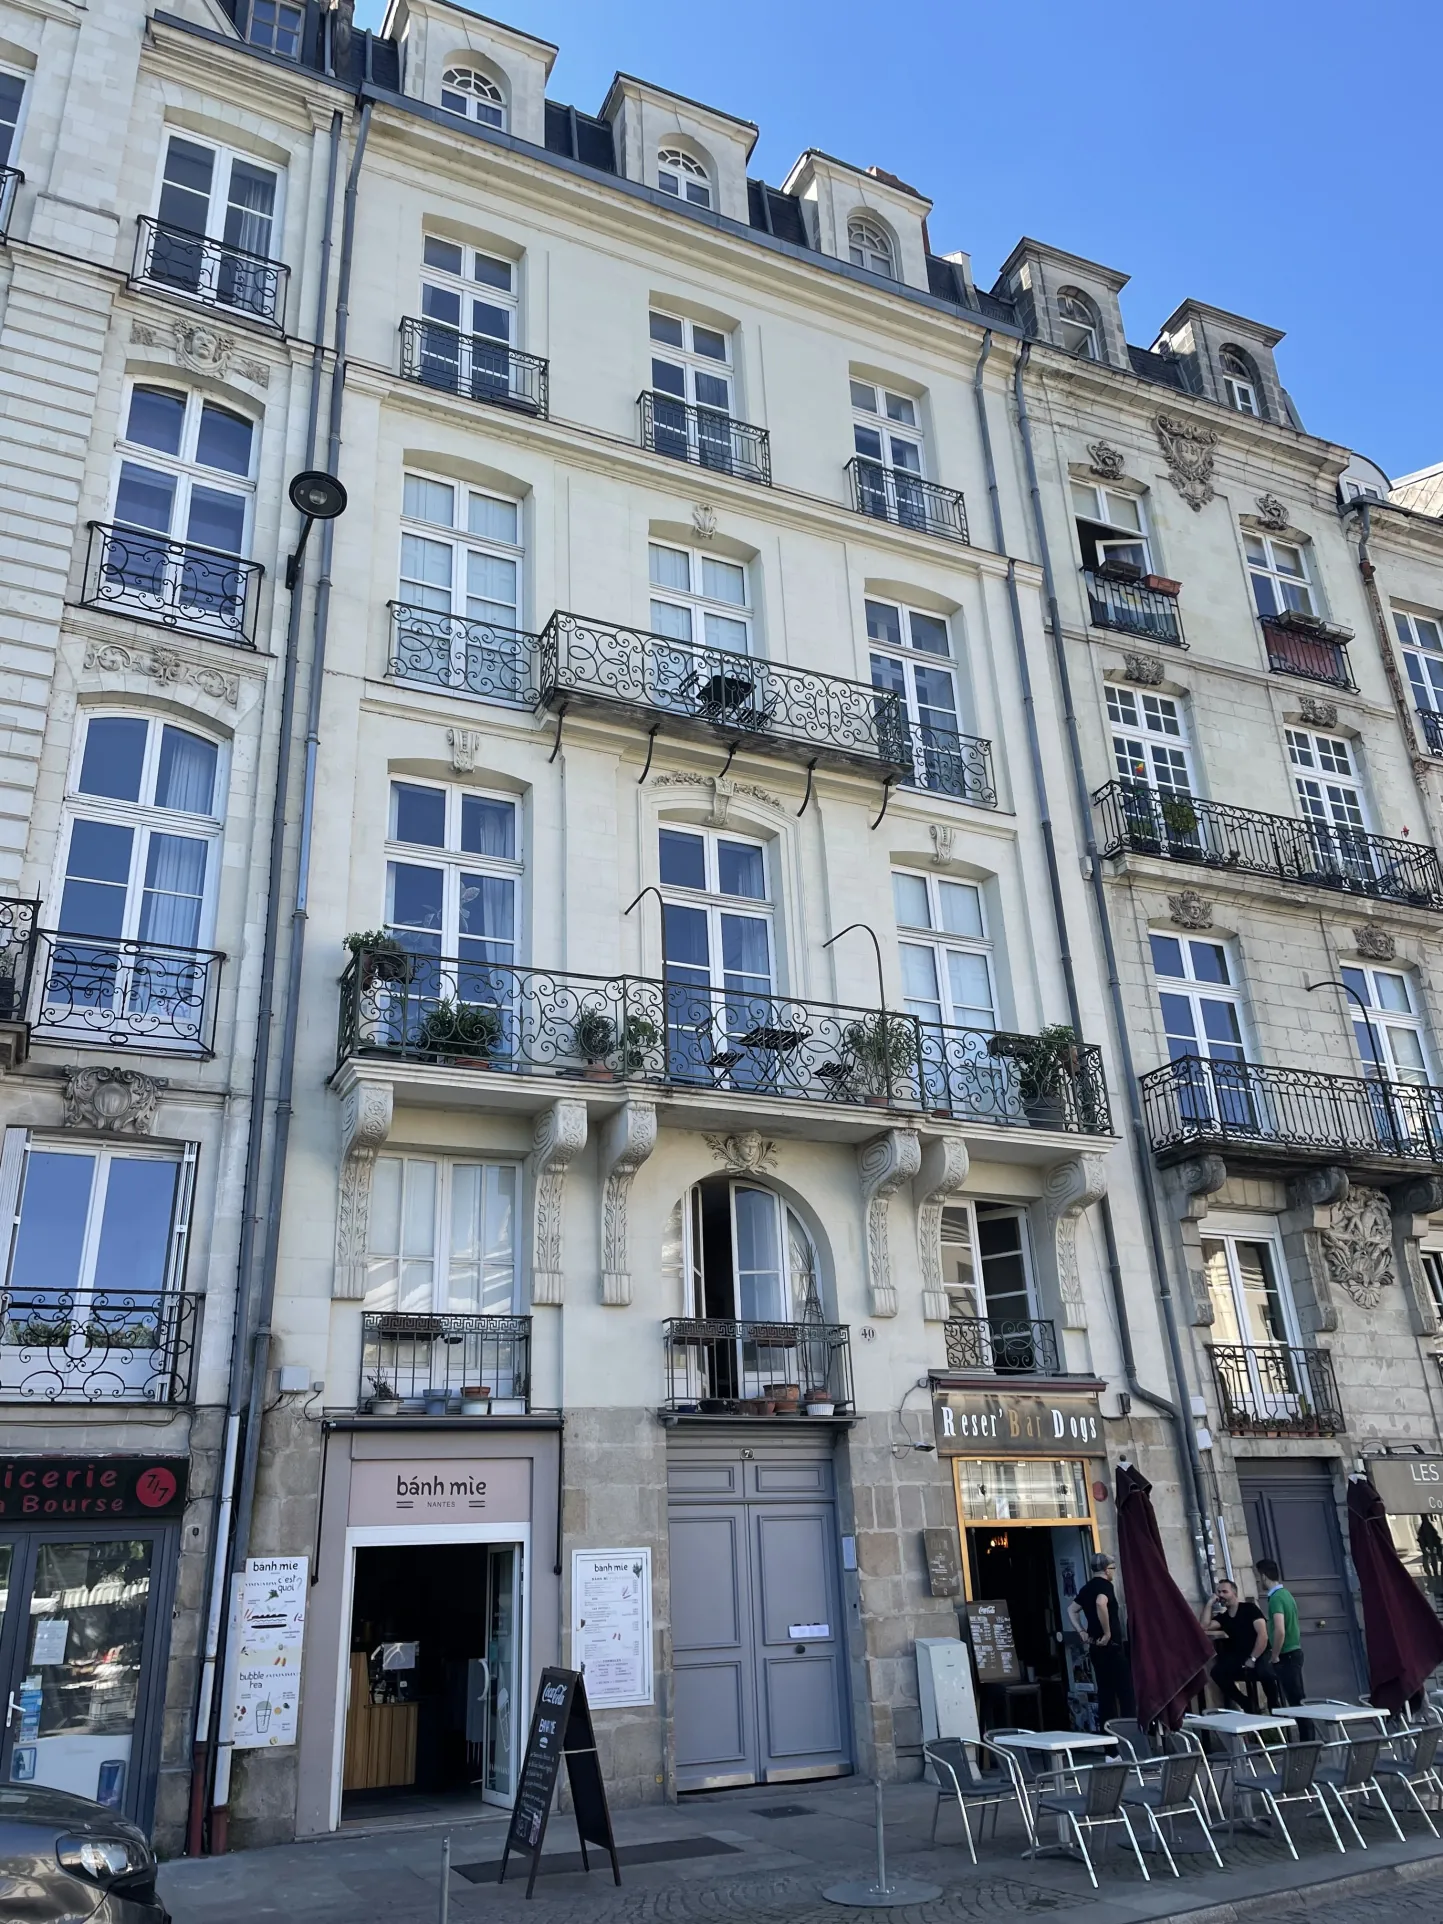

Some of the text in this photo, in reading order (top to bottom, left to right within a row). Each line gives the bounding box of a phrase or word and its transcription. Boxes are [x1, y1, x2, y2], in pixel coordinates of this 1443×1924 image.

[861, 1328, 875, 1339] 40
[1051, 1409, 1097, 1443] Dogs
[744, 1450, 750, 1458] 7
[4, 1464, 118, 1489] icerie
[1410, 1463, 1440, 1481] LES
[147, 1474, 169, 1502] 7/7
[396, 1474, 487, 1496] bánh mìe
[22, 1494, 123, 1513] Bourse
[239, 1671, 265, 1681] bubble
